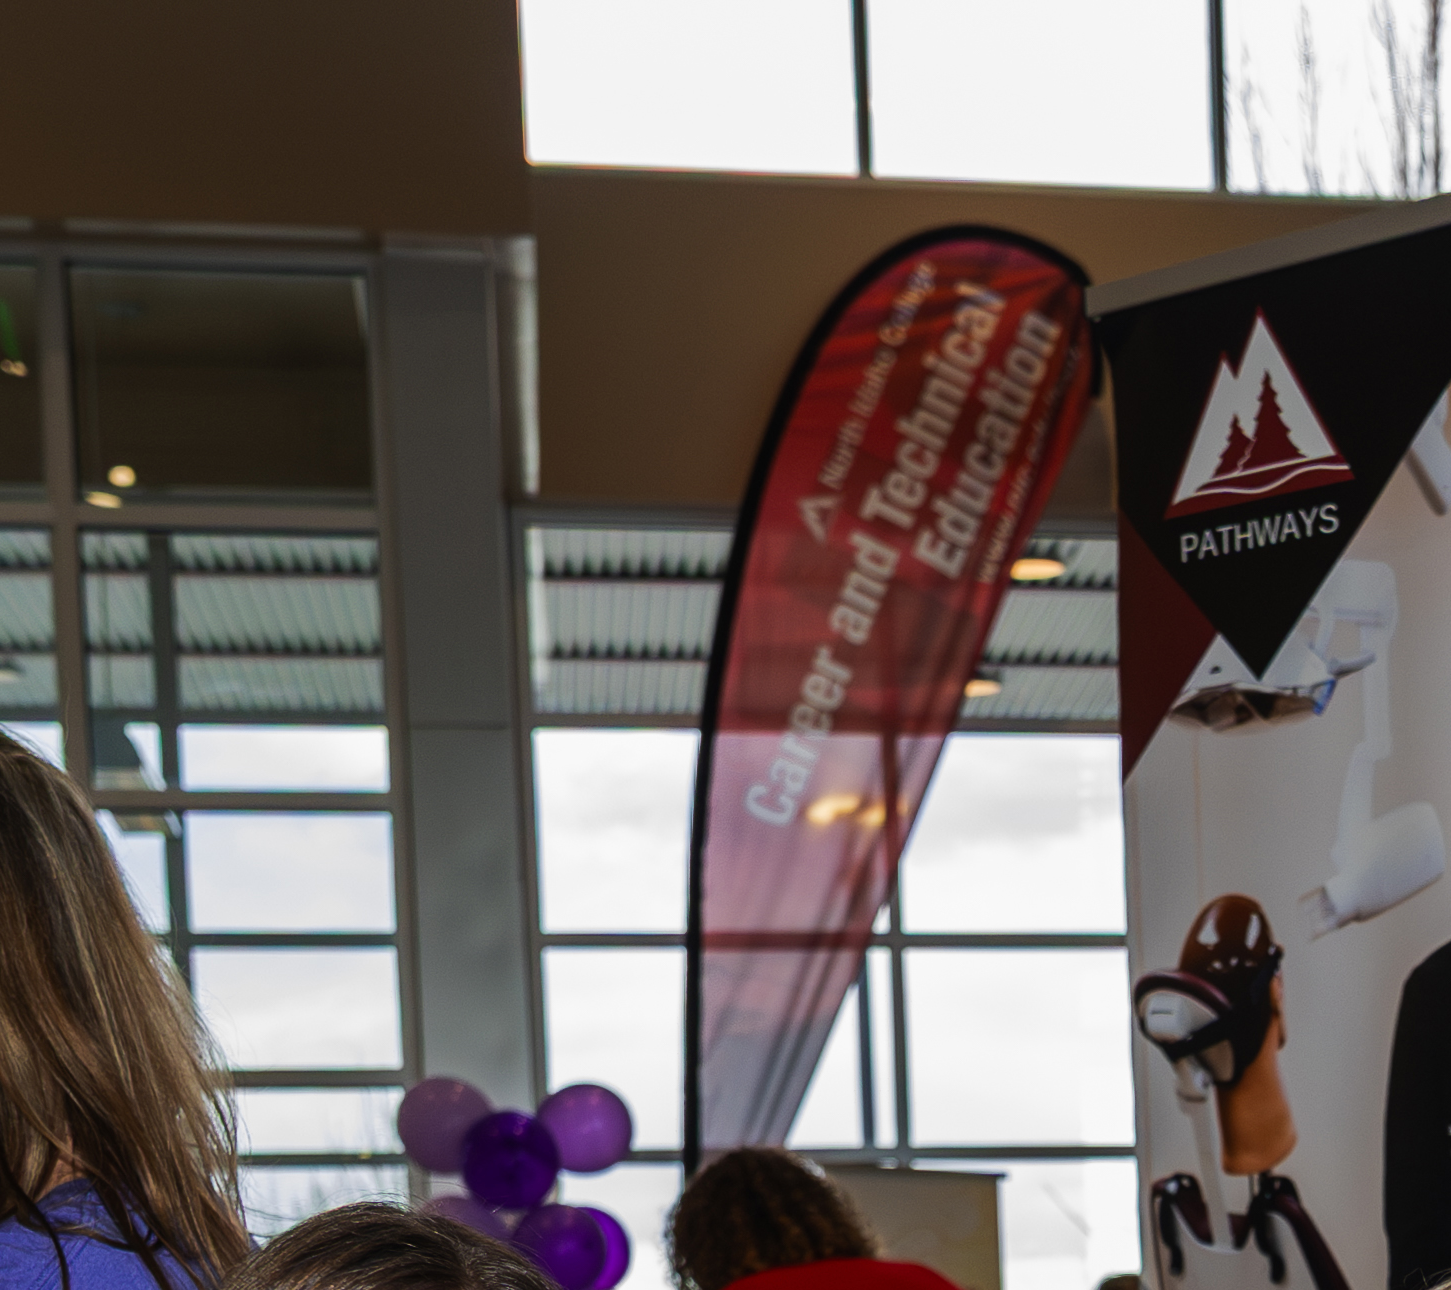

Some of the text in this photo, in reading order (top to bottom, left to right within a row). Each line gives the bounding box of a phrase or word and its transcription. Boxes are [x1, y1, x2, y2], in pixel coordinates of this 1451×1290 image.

[744, 281, 1007, 827] Career and Technical
[915, 311, 1060, 578] Education
[1180, 504, 1340, 562] PATHWAYS
